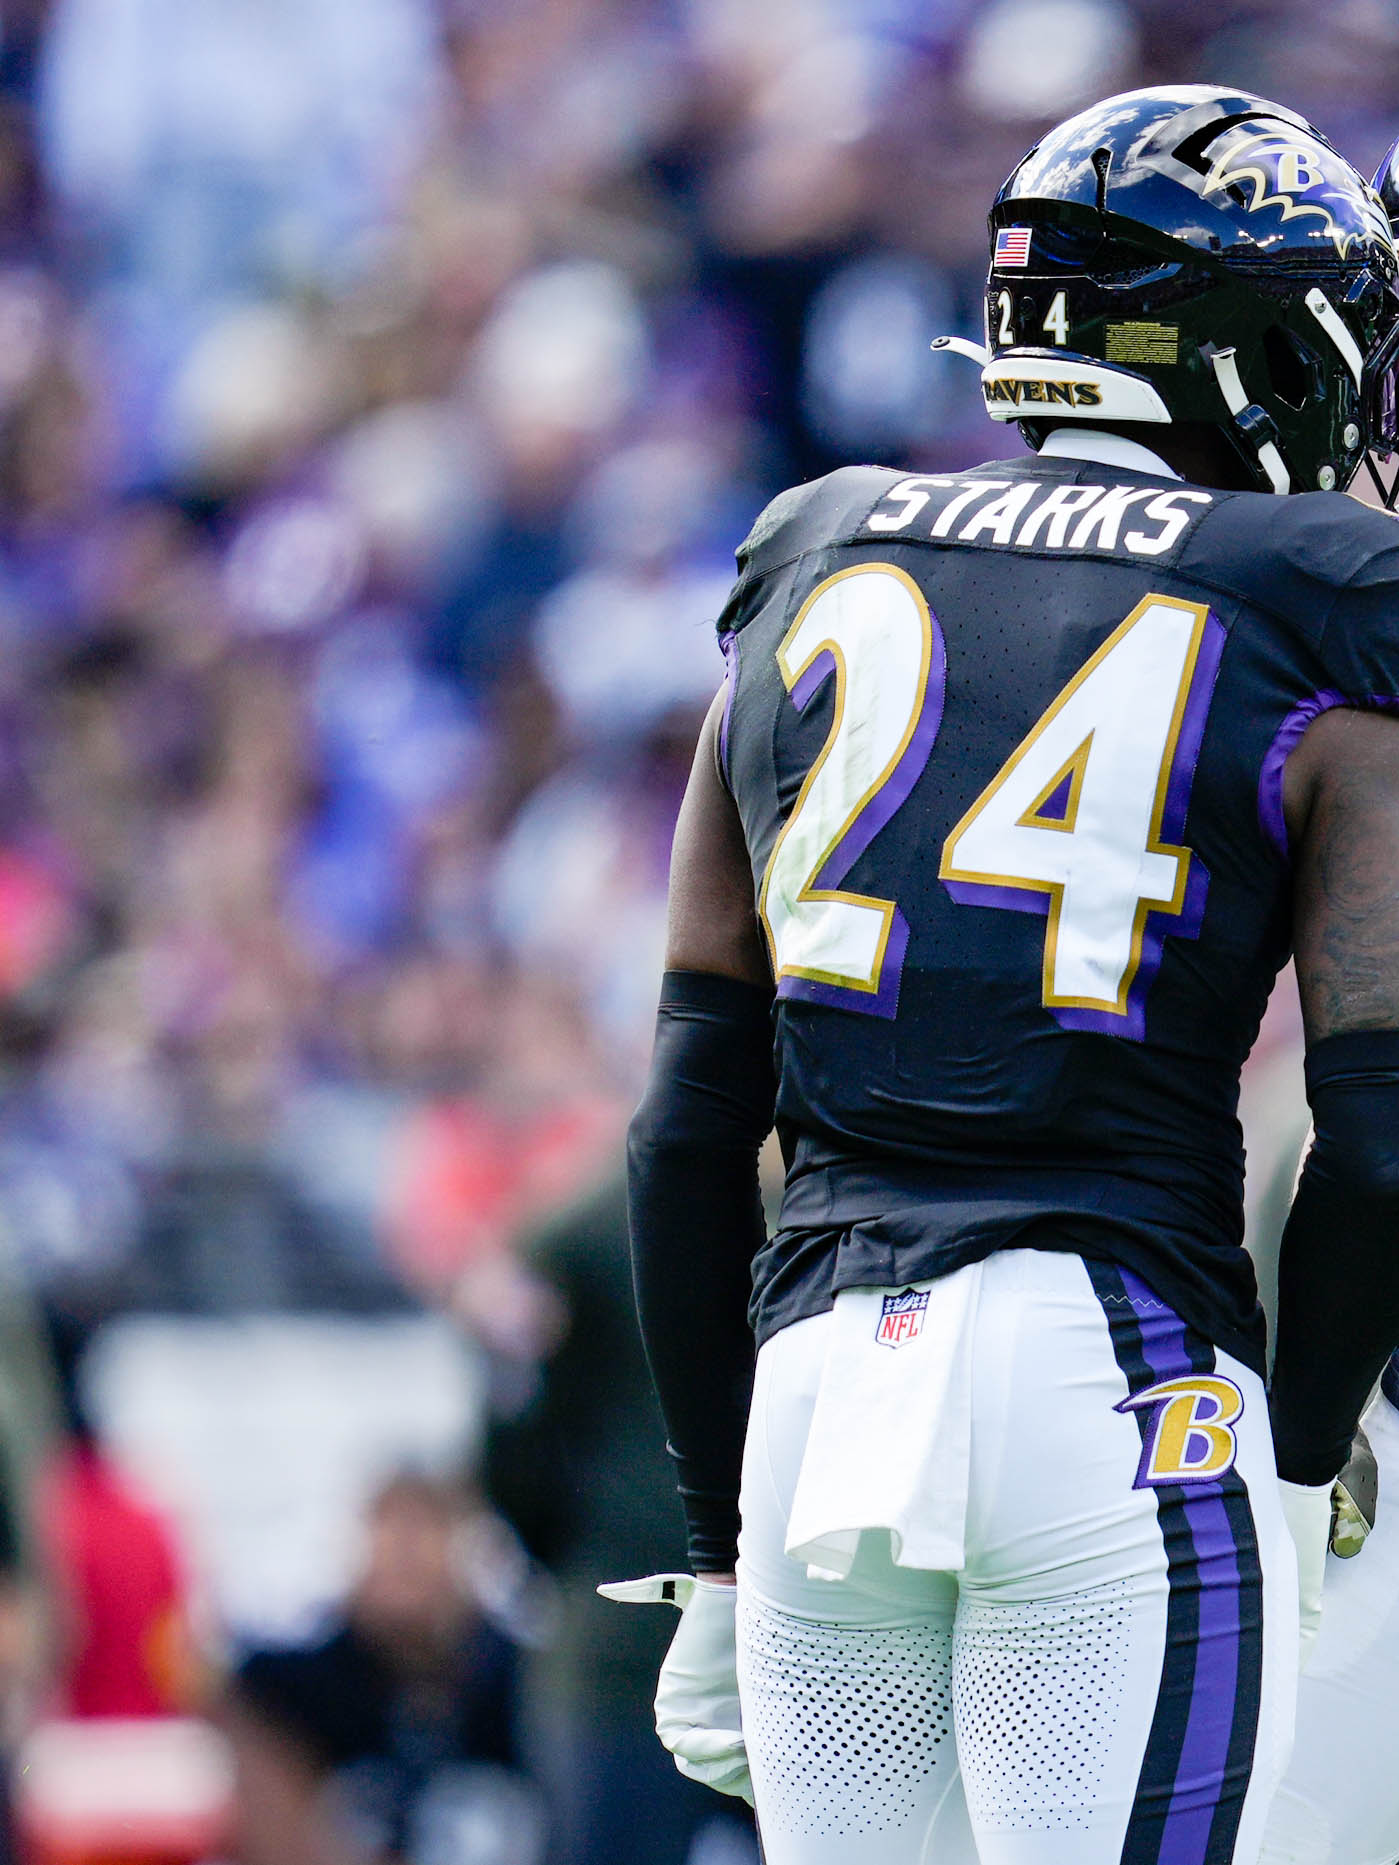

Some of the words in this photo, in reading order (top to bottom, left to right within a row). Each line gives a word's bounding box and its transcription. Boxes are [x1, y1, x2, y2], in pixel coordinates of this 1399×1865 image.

[1247, 144, 1325, 193] B
[866, 478, 1213, 556] STARKS
[759, 562, 1228, 1042] 24
[880, 1313, 918, 1342] NFL
[1112, 1373, 1245, 1490] B
